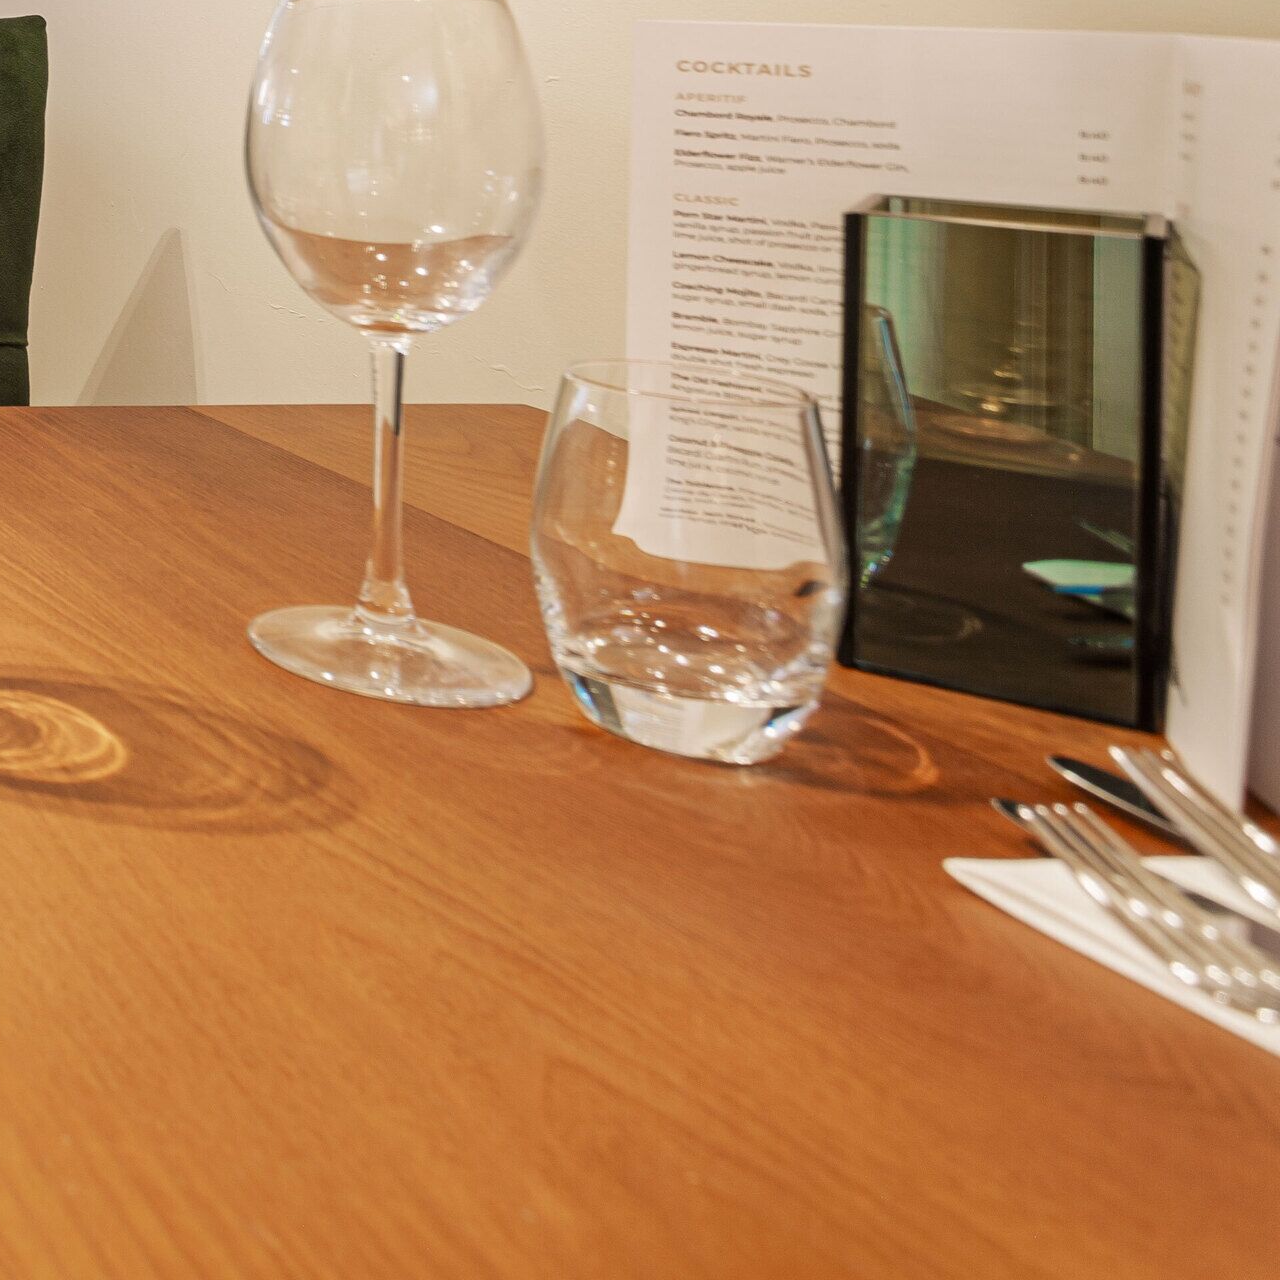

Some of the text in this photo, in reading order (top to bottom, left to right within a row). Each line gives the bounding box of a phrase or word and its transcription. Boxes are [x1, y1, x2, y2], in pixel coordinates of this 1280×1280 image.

[676, 59, 812, 78] COCKTAILS
[675, 92, 747, 104] APERITIF
[673, 193, 739, 206] CLASSIC
